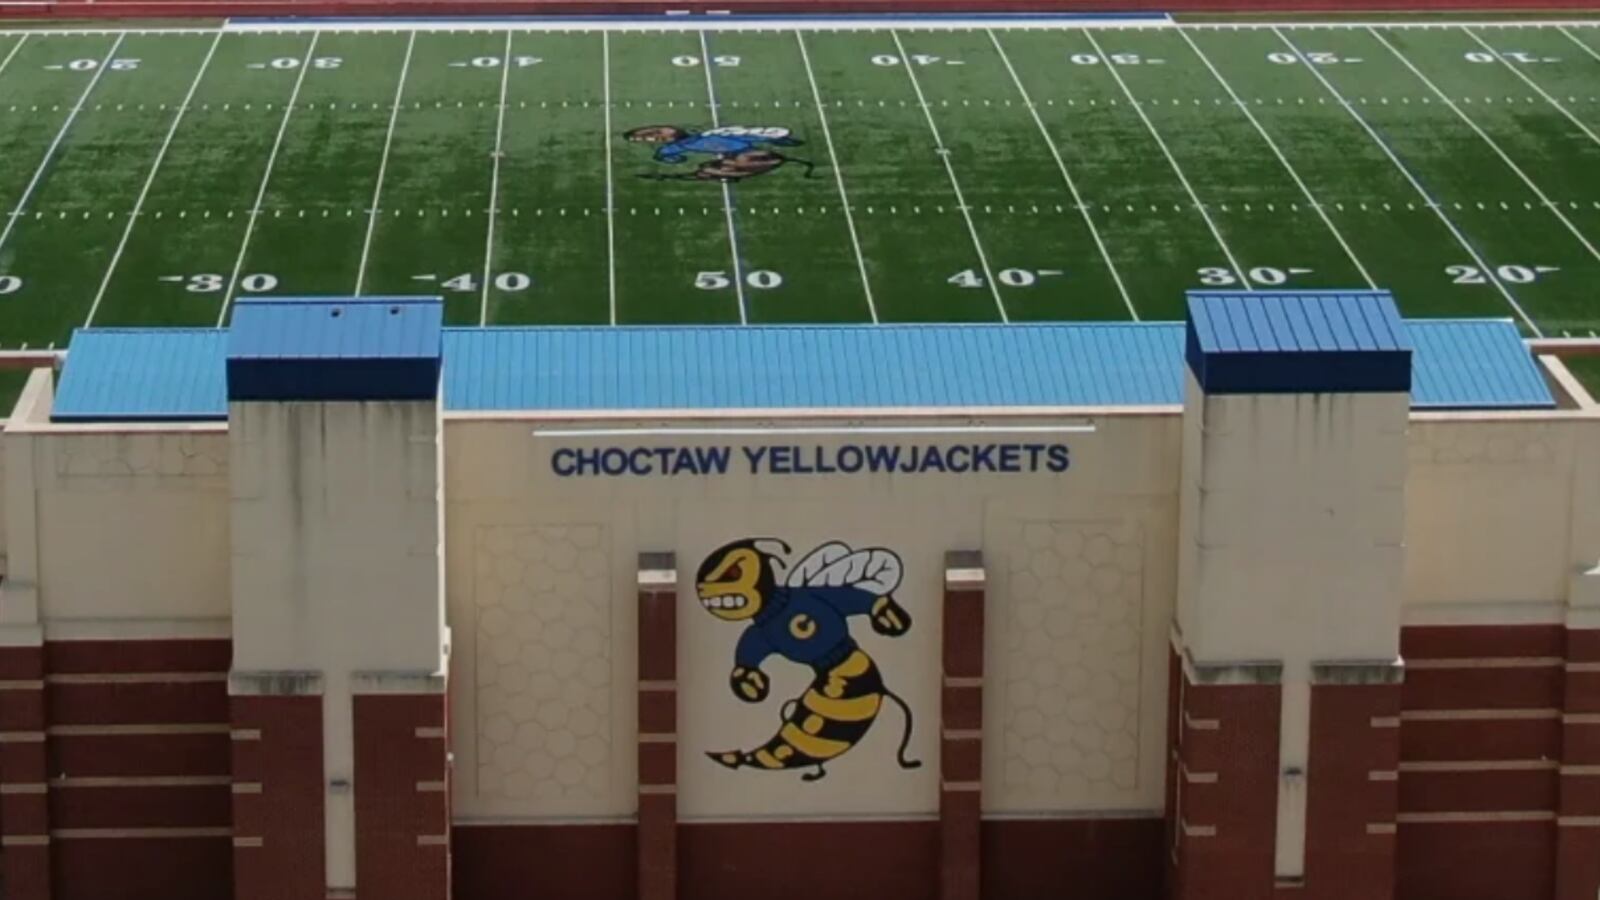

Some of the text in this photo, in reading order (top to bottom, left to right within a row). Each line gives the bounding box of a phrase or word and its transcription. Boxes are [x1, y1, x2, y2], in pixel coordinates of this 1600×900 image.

[186, 273, 279, 292] 30
[440, 273, 531, 291] 40
[694, 271, 783, 289] 50
[946, 269, 1036, 287] 40
[1197, 267, 1288, 285] 30
[1444, 265, 1537, 284] 20
[551, 443, 1070, 477] CHOCTAW YELLOWJACKETS
